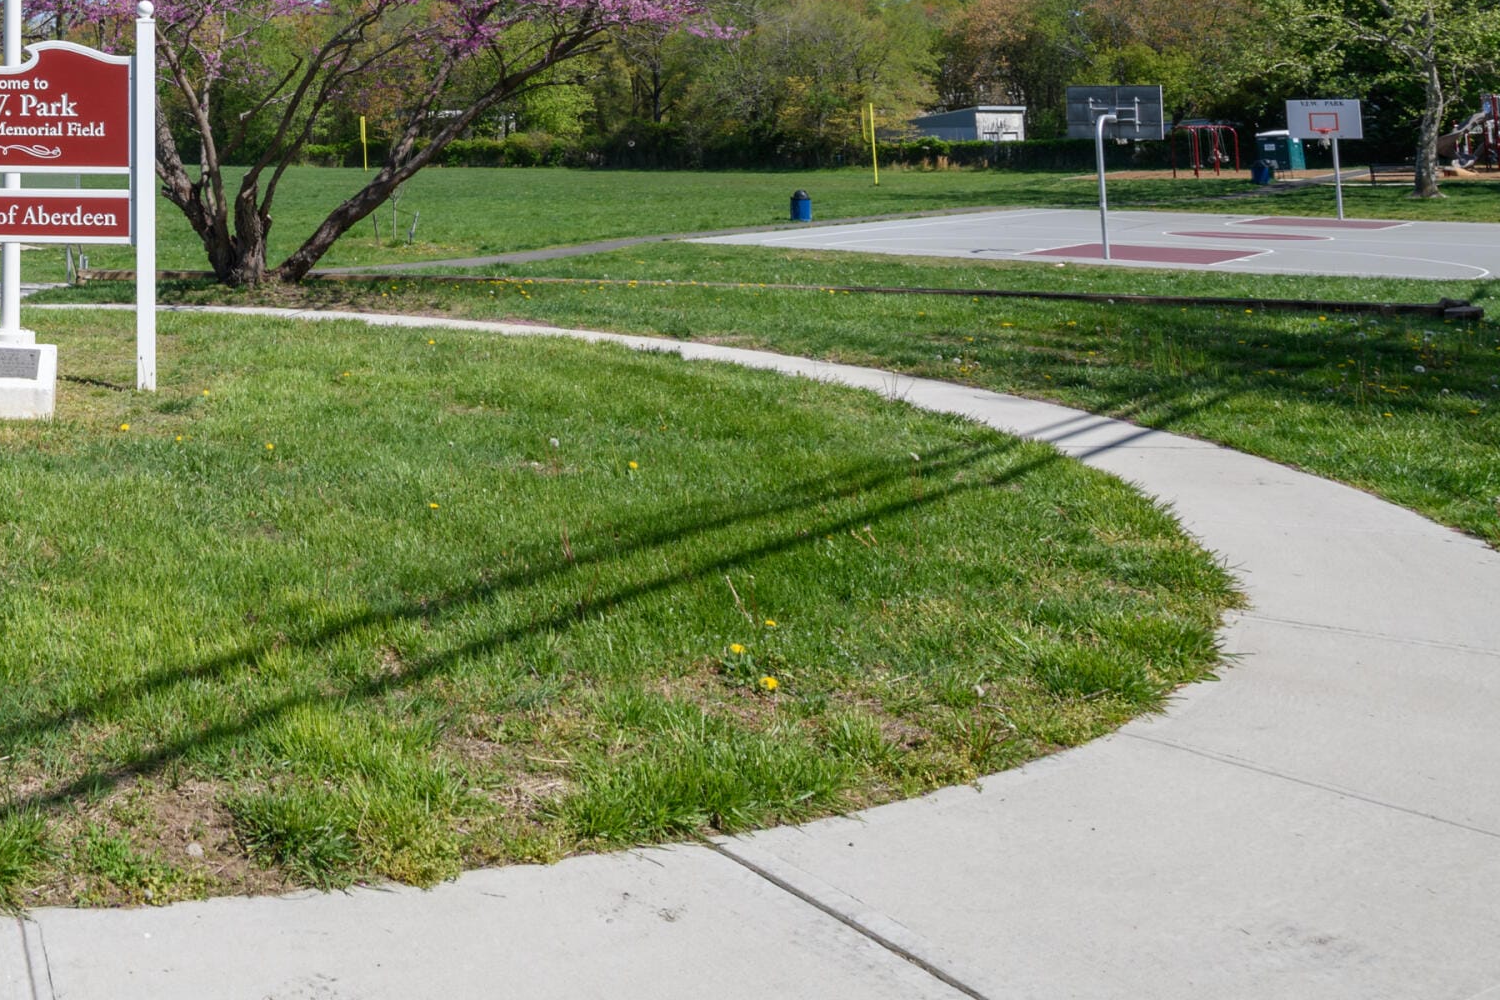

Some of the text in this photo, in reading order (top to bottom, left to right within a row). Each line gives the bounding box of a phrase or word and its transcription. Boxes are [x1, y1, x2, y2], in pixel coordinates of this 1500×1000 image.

[33, 77, 49, 90] to
[19, 92, 79, 117] Park
[66, 121, 106, 137] Field
[21, 205, 118, 227] Aberdeen
